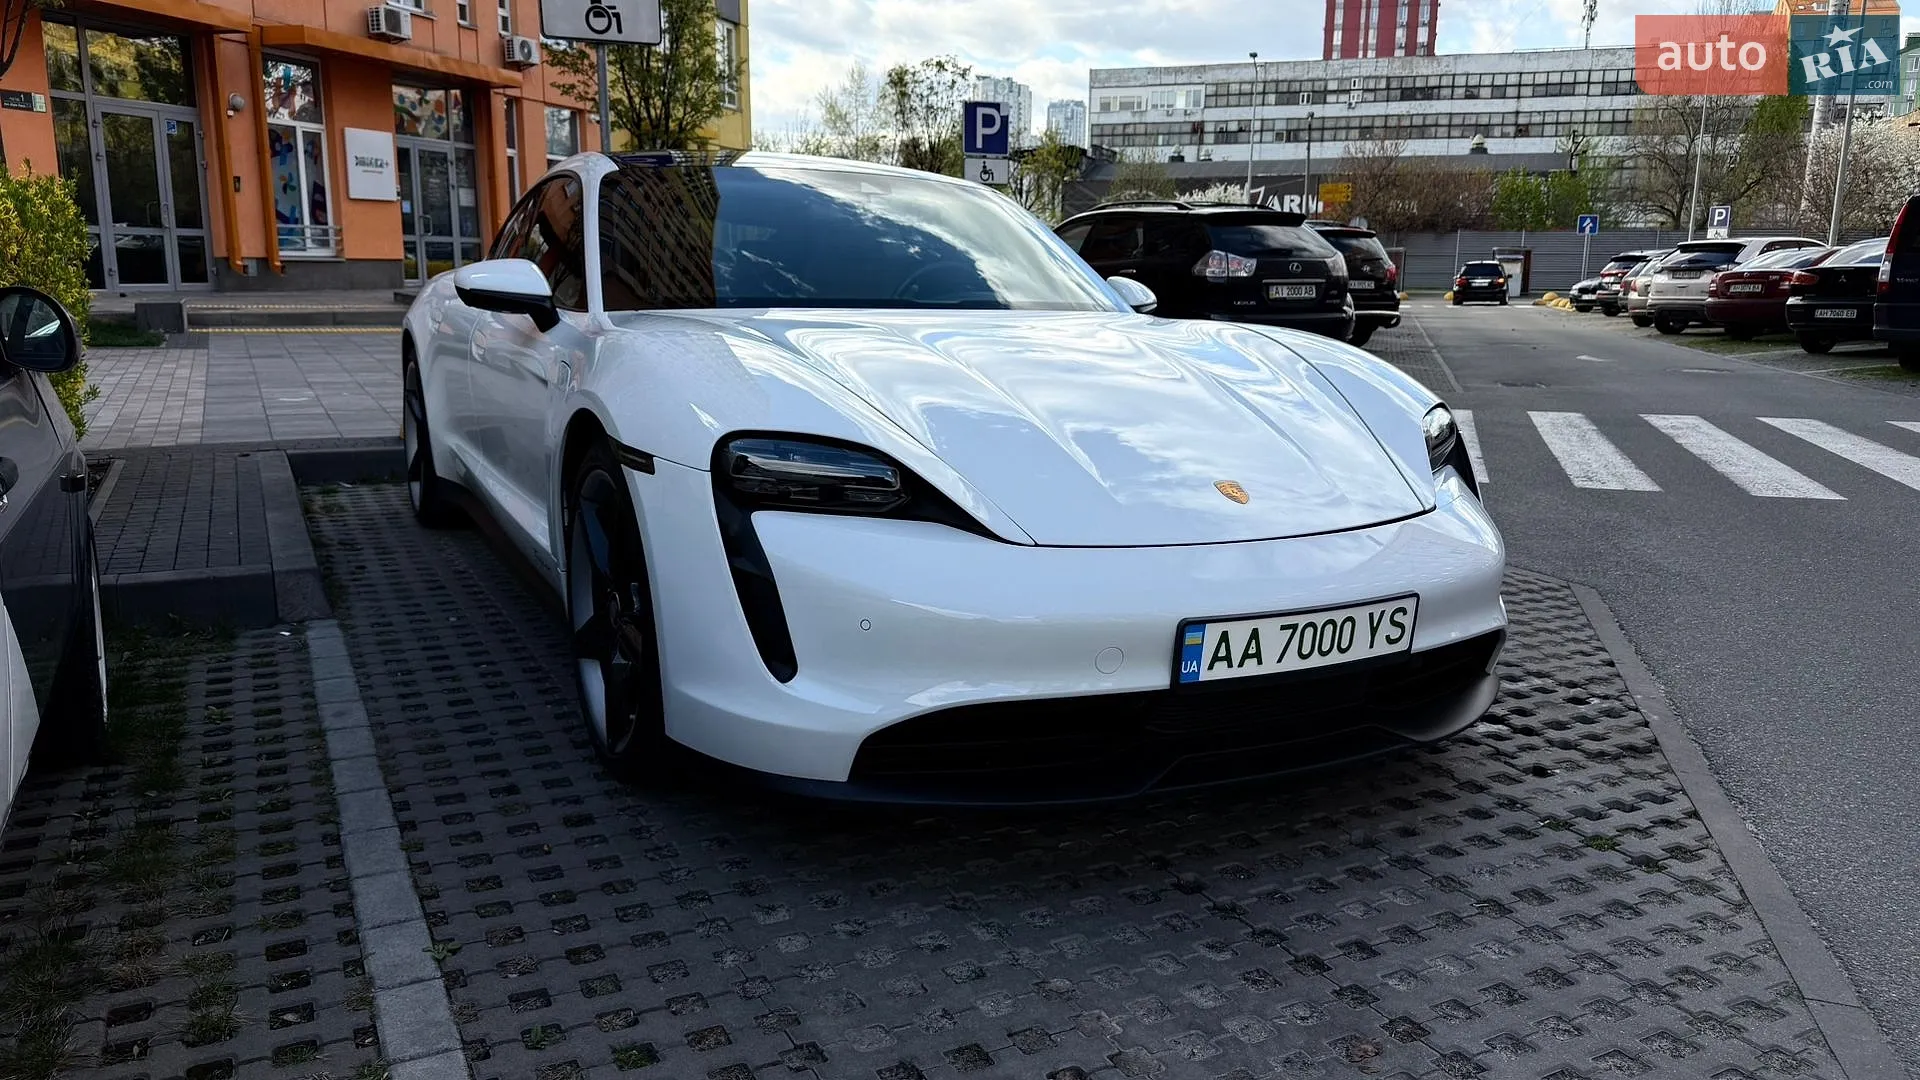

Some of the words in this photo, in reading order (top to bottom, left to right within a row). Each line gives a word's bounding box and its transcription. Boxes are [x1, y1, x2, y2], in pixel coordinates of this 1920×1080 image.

[976, 106, 1002, 149] P
[1713, 208, 1727, 226] P
[1207, 627, 1264, 671] AA
[1276, 615, 1356, 664] 7000
[1368, 606, 1408, 650] YS
[1181, 660, 1198, 674] UA
